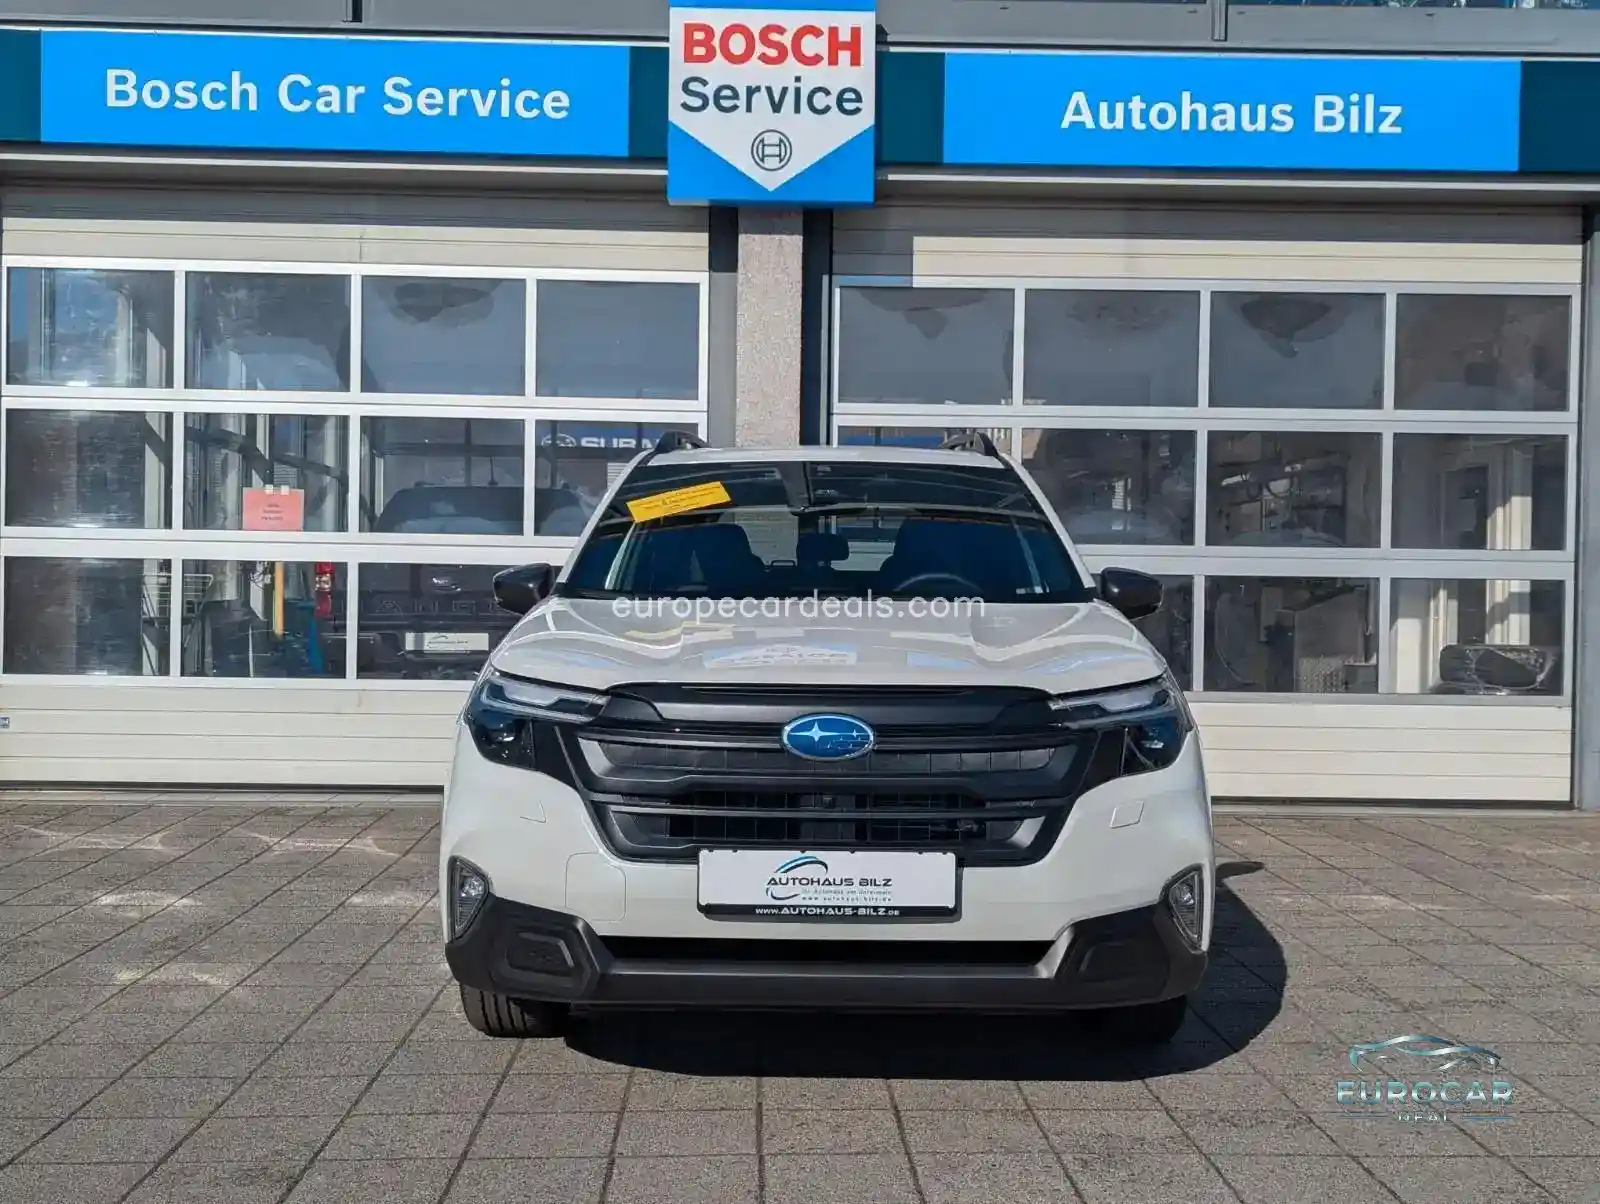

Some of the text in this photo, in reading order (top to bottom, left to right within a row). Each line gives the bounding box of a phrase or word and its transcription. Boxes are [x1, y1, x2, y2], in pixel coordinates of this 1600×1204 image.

[683, 22, 862, 67] BOSCH
[105, 68, 571, 120] Bosch Car Service
[680, 75, 864, 117] Service
[1060, 91, 1404, 136] Autohaus Bilz
[580, 436, 660, 449] SUBA
[767, 877, 893, 888] AUTOHAUS BILZ
